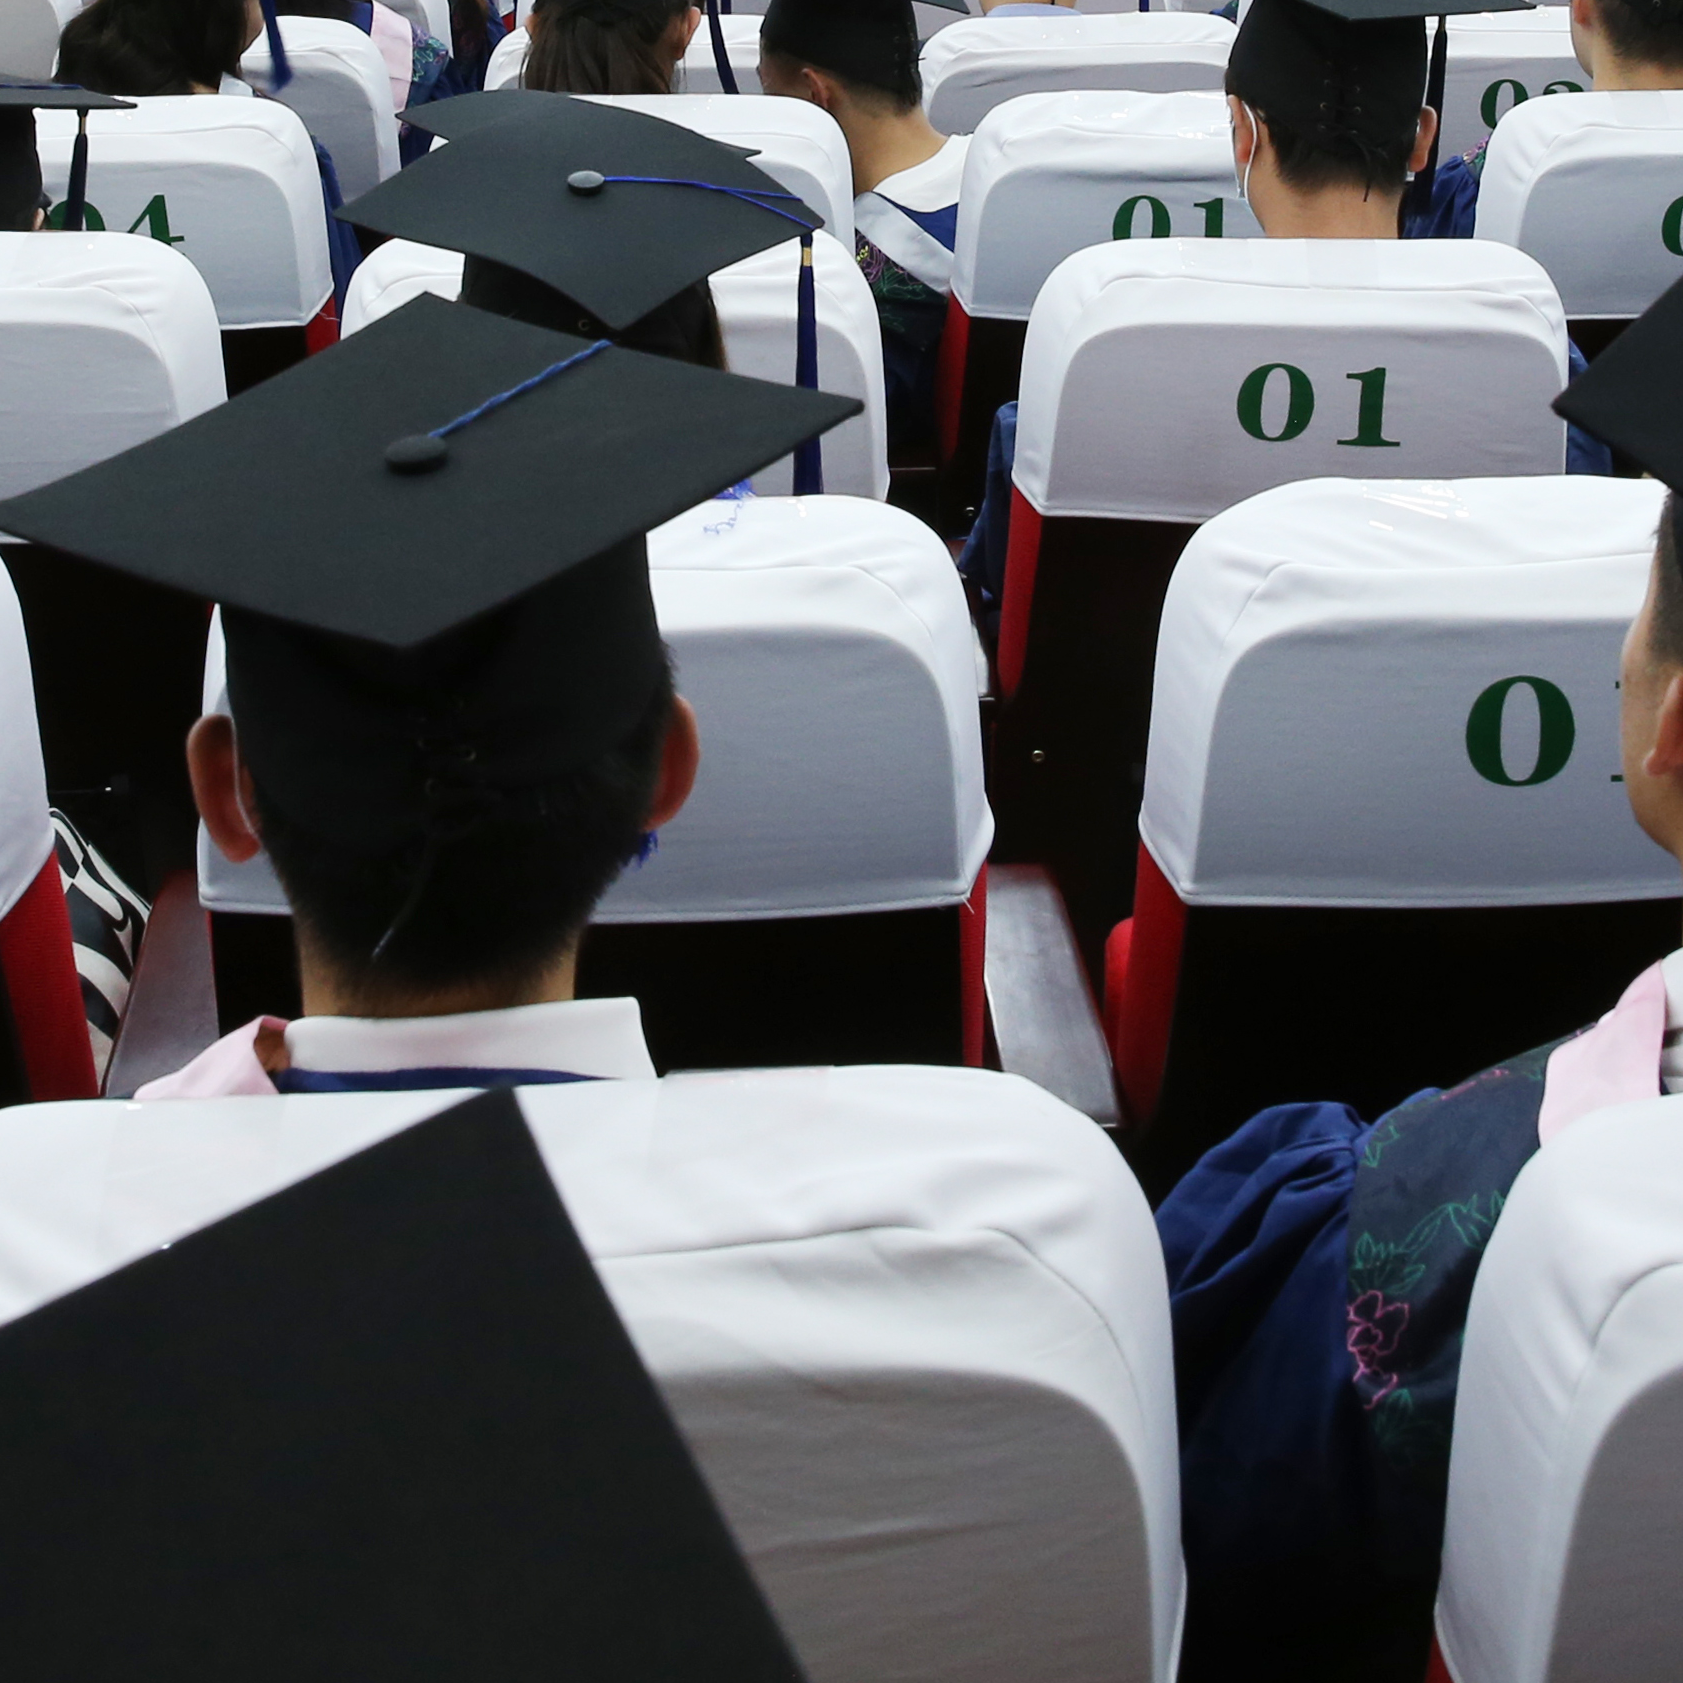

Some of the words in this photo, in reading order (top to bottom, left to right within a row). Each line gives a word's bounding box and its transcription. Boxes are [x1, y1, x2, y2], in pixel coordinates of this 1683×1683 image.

[1480, 78, 1586, 130] 0
[1236, 362, 1402, 448] 01
[1465, 674, 1623, 788] 0
